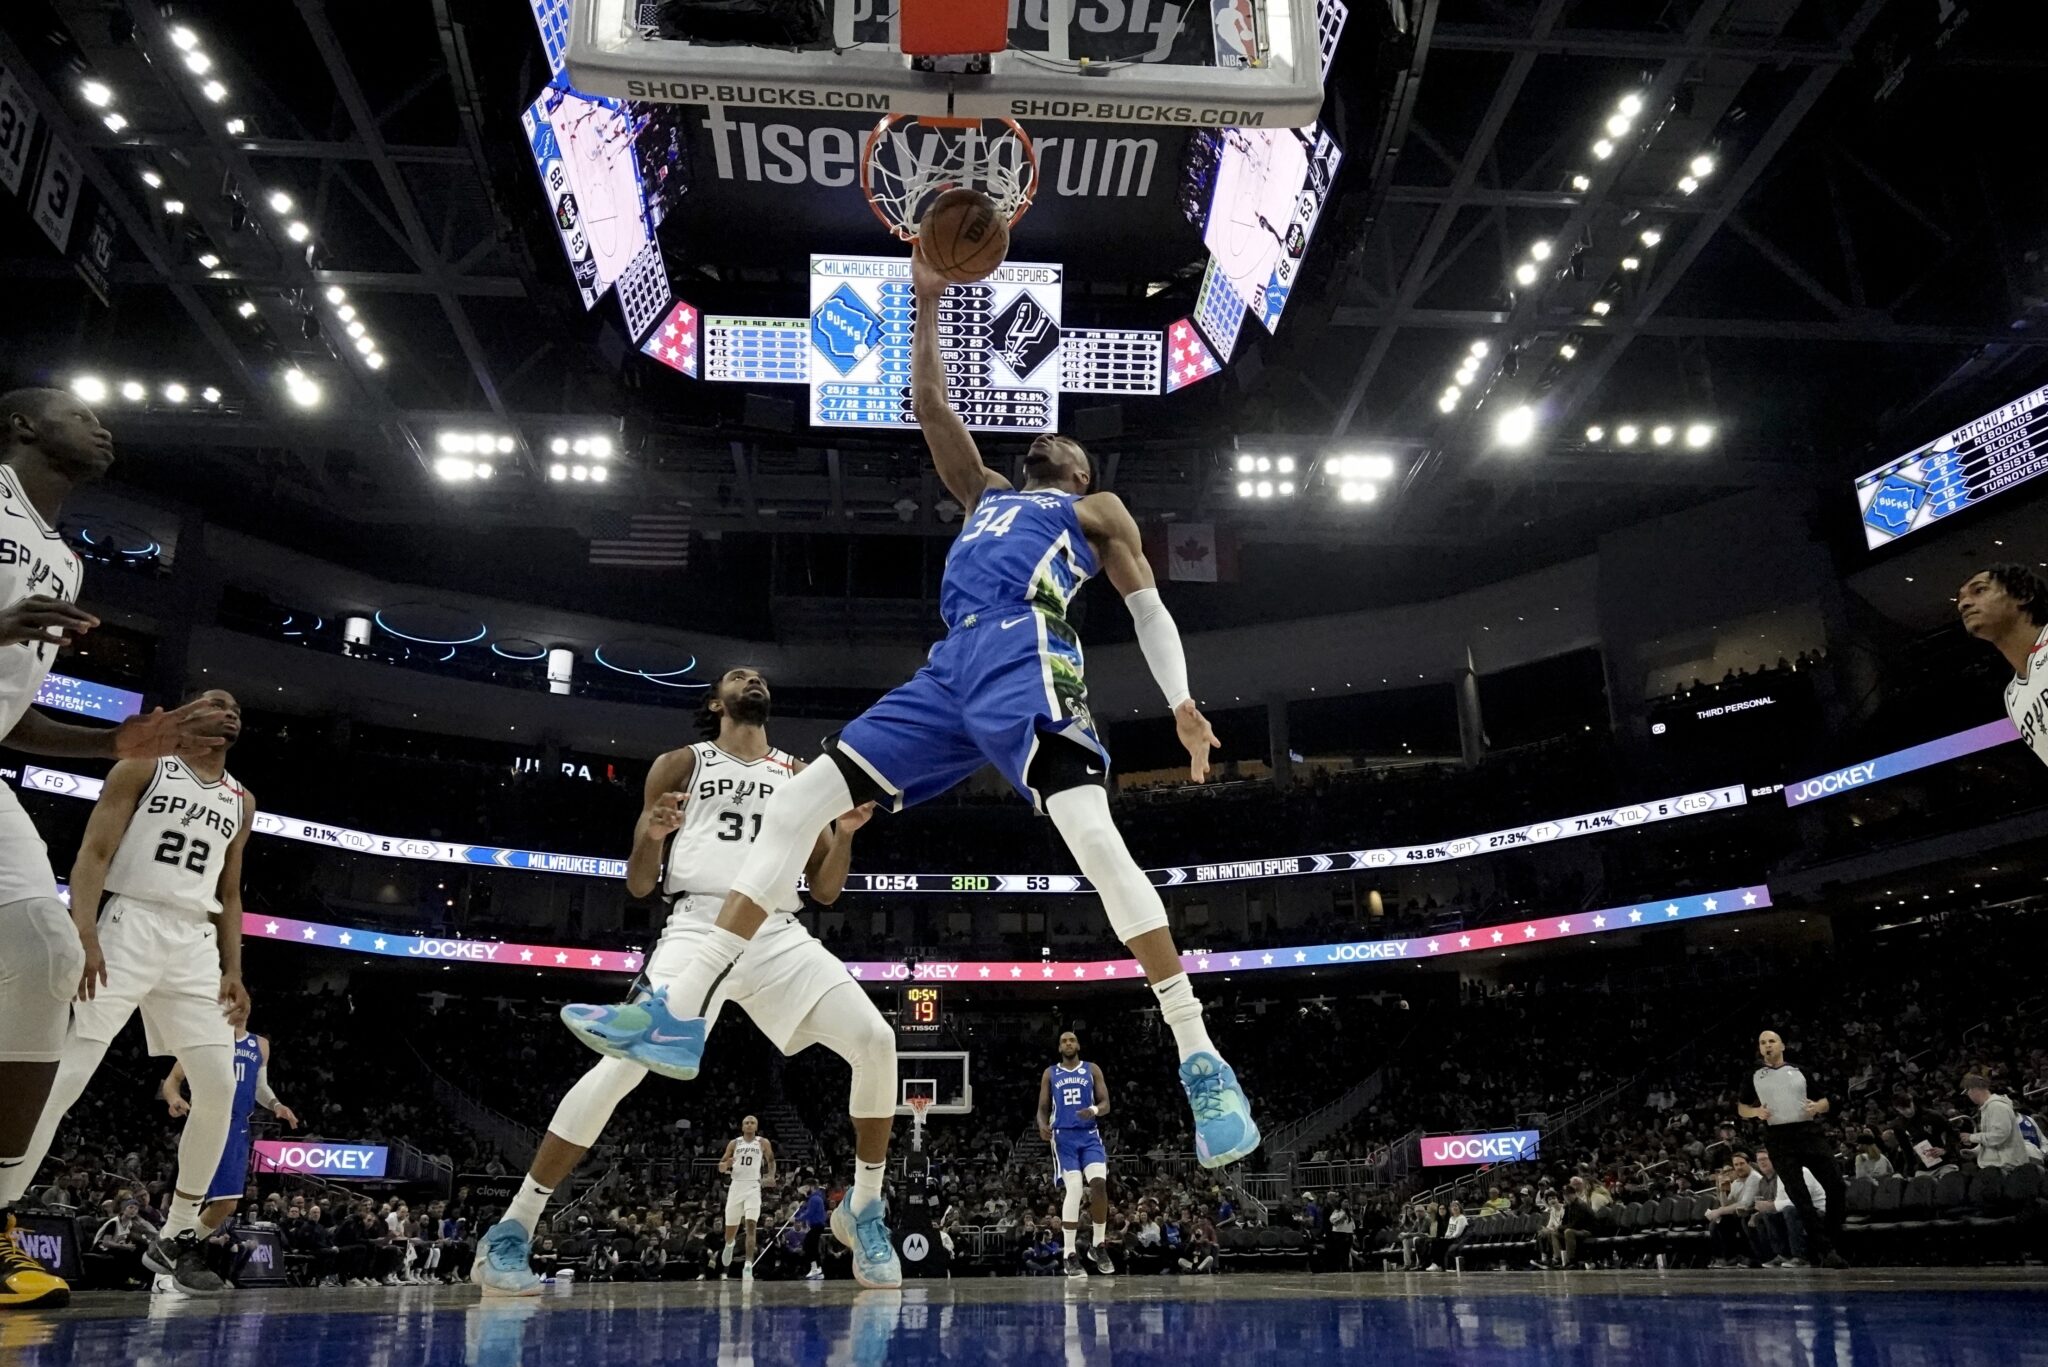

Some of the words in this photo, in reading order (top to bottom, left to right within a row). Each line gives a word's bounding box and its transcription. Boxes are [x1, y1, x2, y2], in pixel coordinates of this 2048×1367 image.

[628, 81, 890, 110] SHOP.BUCKS.COM
[1011, 100, 1264, 126] SHOP.BUCKS.COM
[702, 105, 946, 190] fiserv
[825, 262, 885, 276] MILWAUKEE
[991, 269, 1014, 281] ONIO
[1017, 269, 1049, 282] SPURS
[892, 285, 902, 293] 12
[827, 310, 860, 341] BUCKS
[1952, 410, 2005, 446] MATCHUP
[1934, 455, 1949, 468] 23
[1974, 412, 2033, 446] REBOUNDS
[1940, 467, 1948, 476] 2
[1984, 428, 2028, 454] BLOCKS
[1943, 478, 1950, 486] 7
[1988, 440, 2031, 465] STEALS
[1943, 488, 1955, 499] 12
[1989, 451, 2036, 478] ASSISTS
[1948, 501, 1956, 510] 9
[1982, 457, 2048, 494] TURNOVERS
[1880, 497, 1909, 510] BUCKS
[962, 505, 1022, 542] 34
[33, 696, 84, 712] ECTION
[46, 692, 101, 710] AMERICA
[1697, 707, 1723, 719] THIRD
[44, 775, 64, 788] FG
[1795, 763, 1876, 802] JOCKEY
[1683, 797, 1707, 810] FLS
[1724, 793, 1731, 803] 1
[148, 795, 235, 839] SPURS
[1619, 809, 1642, 822] TOL
[1658, 804, 1668, 815] 5
[256, 817, 272, 829] FT
[717, 811, 762, 843] 31
[1575, 815, 1613, 832] 71.4%
[303, 825, 337, 842] 61.1%
[1490, 831, 1527, 847] 27.3%
[1536, 826, 1550, 838] FT
[344, 834, 366, 848] TOL
[382, 841, 391, 852] 5
[1452, 841, 1473, 854] 3PT
[154, 830, 210, 875] 22
[407, 843, 430, 856] FLS
[448, 848, 454, 858] 1
[1371, 852, 1386, 863] FG
[1406, 847, 1446, 861] 43.8%
[528, 854, 597, 874] MILWAUKEE
[1197, 866, 1217, 881] SAN
[1219, 862, 1263, 879] ANTONIO
[1264, 858, 1299, 876] SPURS
[865, 876, 918, 890] 10:54
[951, 876, 990, 890] 3RD
[1026, 876, 1050, 890] 53
[408, 939, 499, 960] JOCKEY
[1328, 942, 1408, 962] JOCKEY
[882, 965, 959, 978] JOCKEY
[908, 989, 937, 1001] 10:54
[914, 1001, 934, 1022] 19
[236, 1063, 245, 1082] 11
[1055, 1077, 1089, 1089] MILWAUKEE
[1063, 1088, 1082, 1106] 22
[1434, 1136, 1527, 1161] JOCKEY
[267, 1147, 374, 1169] JOCKEY
[740, 1156, 753, 1166] 10
[476, 1185, 510, 1197] clover
[18, 1230, 62, 1268] way
